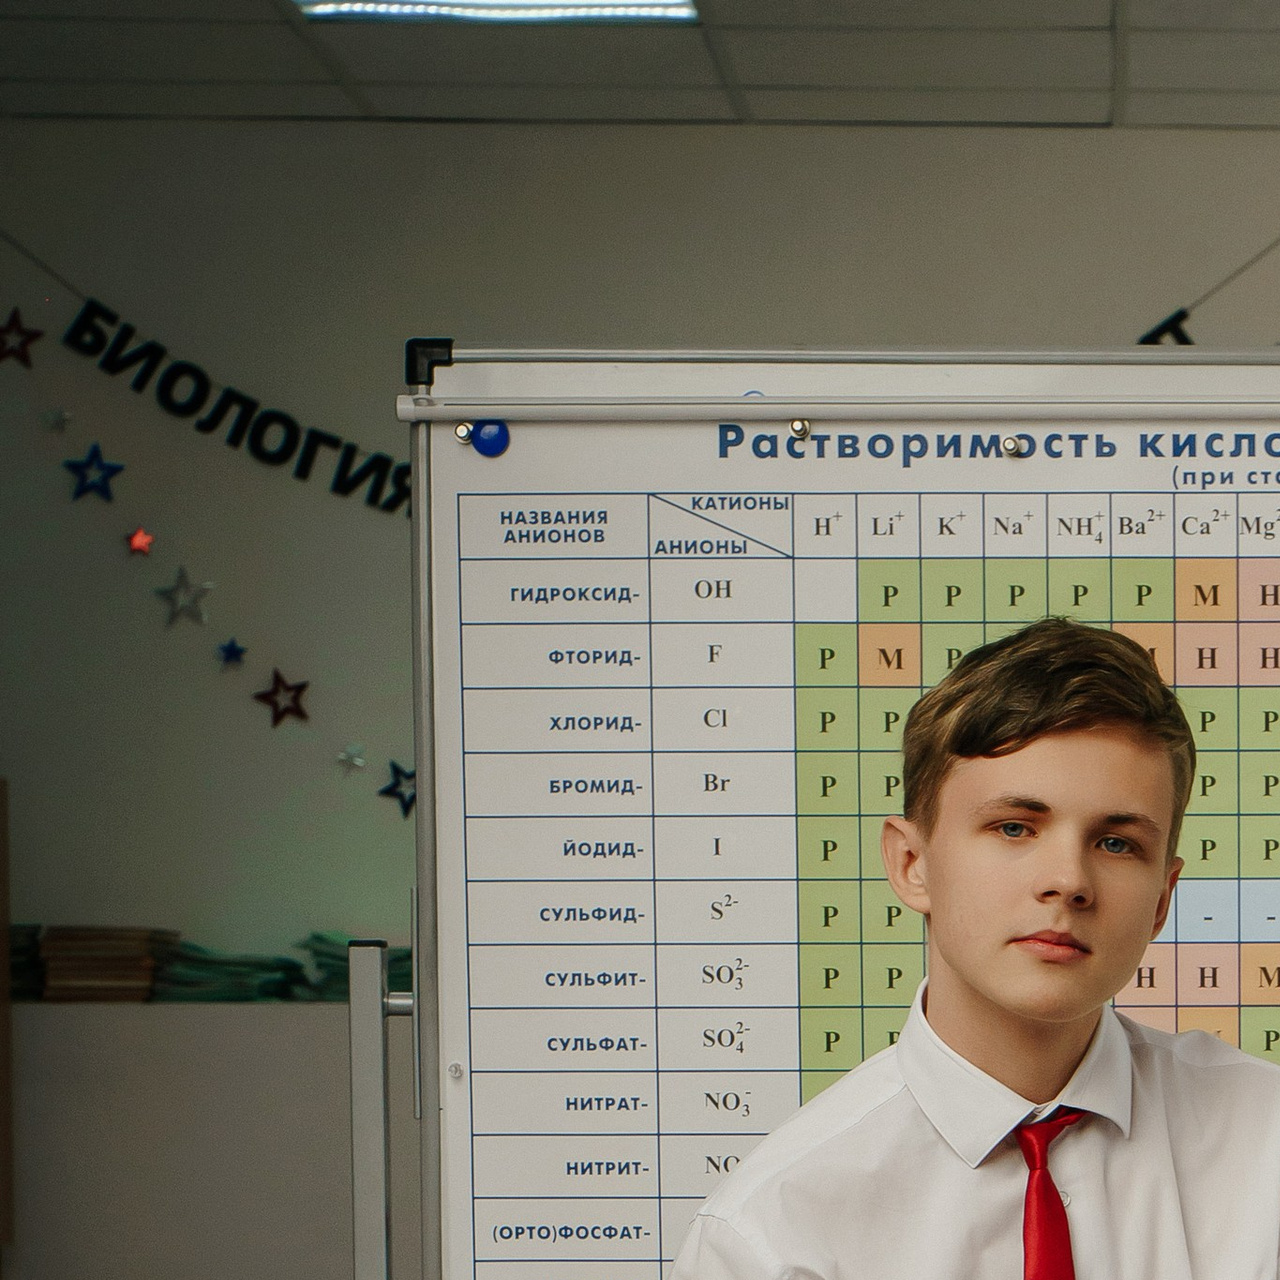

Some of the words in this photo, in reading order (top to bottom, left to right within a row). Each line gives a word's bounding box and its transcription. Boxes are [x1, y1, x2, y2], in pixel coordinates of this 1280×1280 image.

[717, 423, 1117, 468] Растворимость
[1172, 465, 1234, 490] (при
[690, 496, 790, 513] КАТИОНЫ
[500, 510, 608, 525] НАЗВАНИЯ
[503, 529, 605, 544] АНИОНОВ
[654, 540, 747, 555] АНИОНЫ
[510, 587, 640, 604] ГИДРОКСИД-
[694, 580, 731, 599] OH
[883, 585, 899, 607] Р
[945, 585, 962, 607] Р
[1009, 585, 1025, 607] Р
[1073, 584, 1089, 607] Р
[1136, 584, 1152, 606] Р
[1194, 584, 1219, 606] М
[1260, 584, 1280, 606] Н
[548, 650, 641, 667] ФТОРИД-
[707, 643, 723, 665] F
[819, 648, 835, 670] Р
[878, 648, 903, 670] М
[549, 716, 642, 733] ХЛОРИД-
[703, 709, 727, 728] Cl
[820, 711, 836, 733] Р
[549, 779, 643, 796] БРОМИД-
[704, 773, 731, 792] Br
[821, 775, 837, 798] Р
[563, 839, 644, 859] ЙОДИД-
[712, 836, 722, 858] I
[822, 839, 838, 862] Р
[539, 907, 645, 924] СУЛЬФИД-
[886, 905, 902, 927] Р
[545, 972, 646, 987] СУЛЬФИТ-
[547, 1037, 647, 1052] СУЛЬФАТ-
[824, 1031, 841, 1053] Р
[566, 1097, 648, 1111] НИТРАТ-
[566, 1161, 649, 1176] НИТРИТ-
[493, 1225, 651, 1243] (ОРТО)ФОСФАТ-
